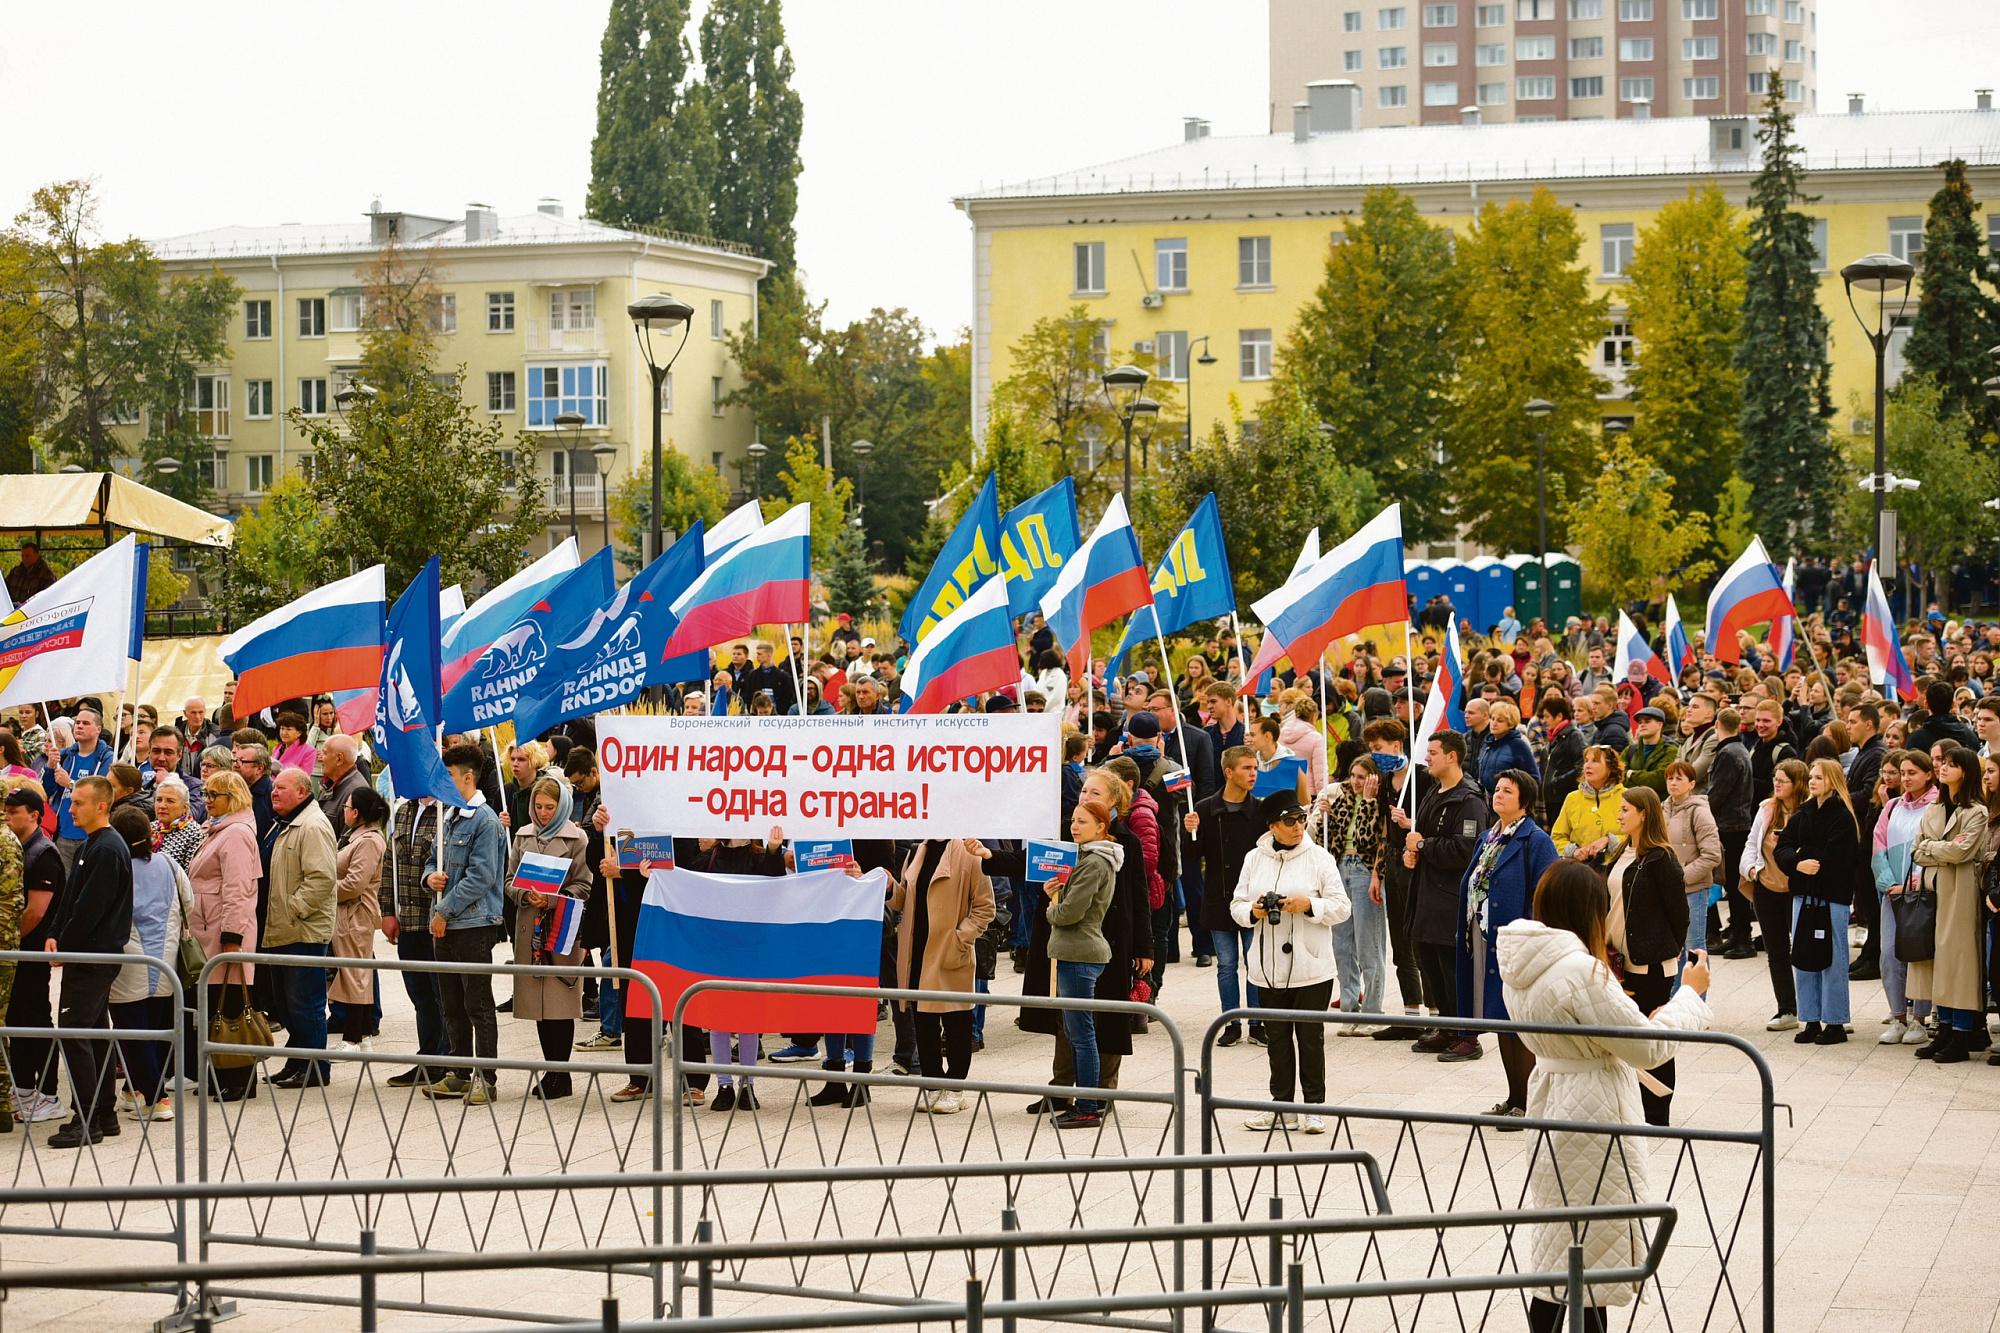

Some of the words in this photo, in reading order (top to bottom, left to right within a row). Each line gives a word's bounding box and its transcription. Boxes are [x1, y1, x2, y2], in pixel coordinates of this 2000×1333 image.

[670, 717, 751, 730] Воронежский
[758, 716, 864, 730] государственный
[874, 717, 928, 729] институт
[935, 717, 989, 729] искусств
[602, 736, 679, 777] Один
[688, 745, 788, 781] народ
[907, 745, 1048, 782] история
[799, 783, 929, 827] страна!
[642, 850, 671, 859] БРОСАЕМ
